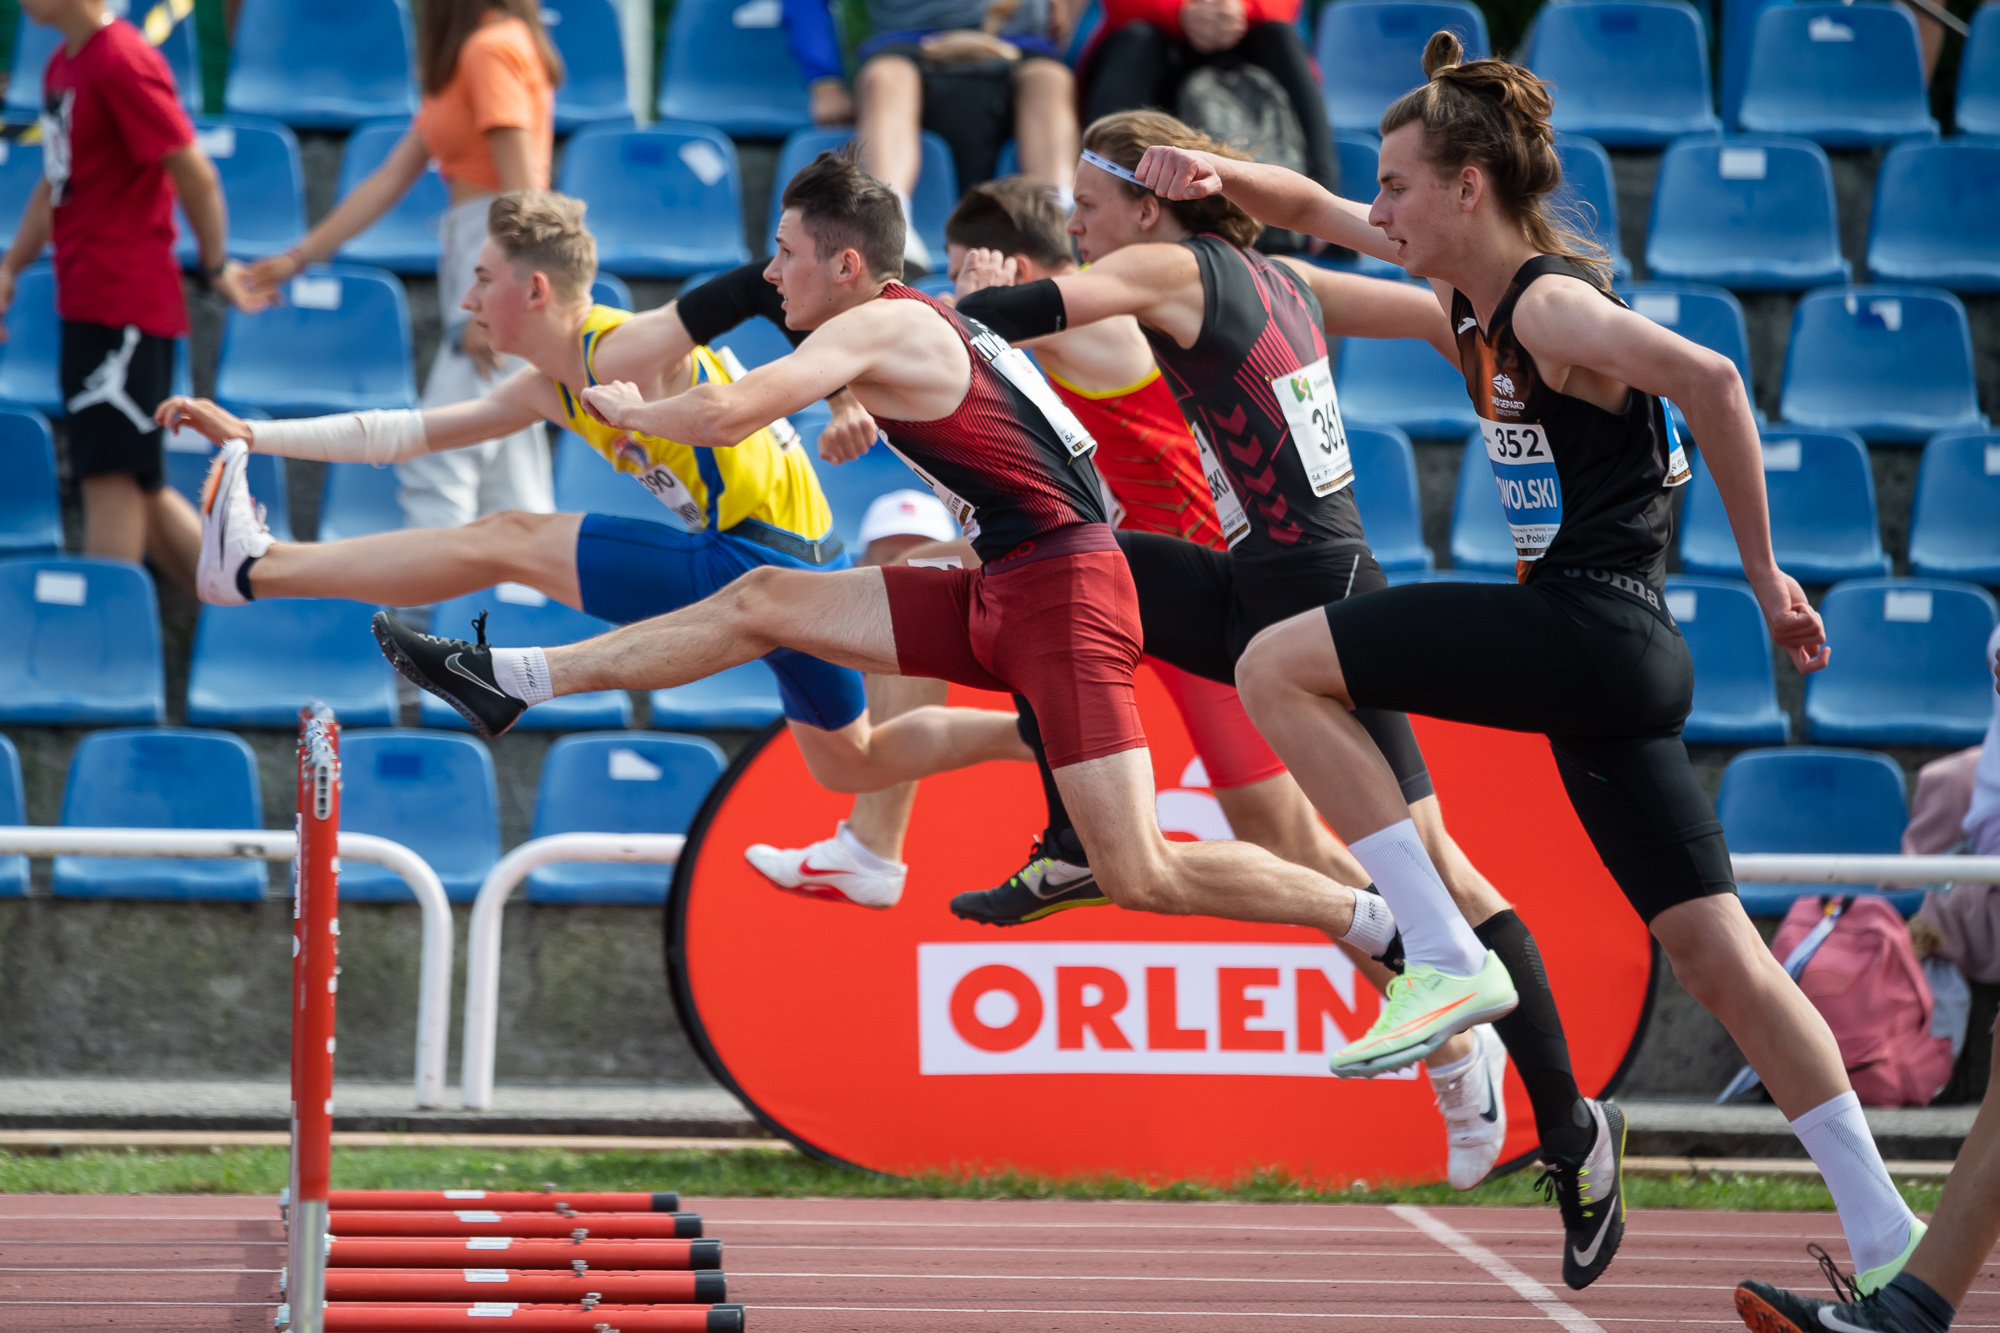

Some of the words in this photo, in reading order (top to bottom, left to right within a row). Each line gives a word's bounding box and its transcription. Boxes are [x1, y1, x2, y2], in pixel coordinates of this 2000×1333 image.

[1312, 400, 1346, 455] 361
[1495, 427, 1545, 459] 352
[948, 963, 1382, 1054] ORLEN
